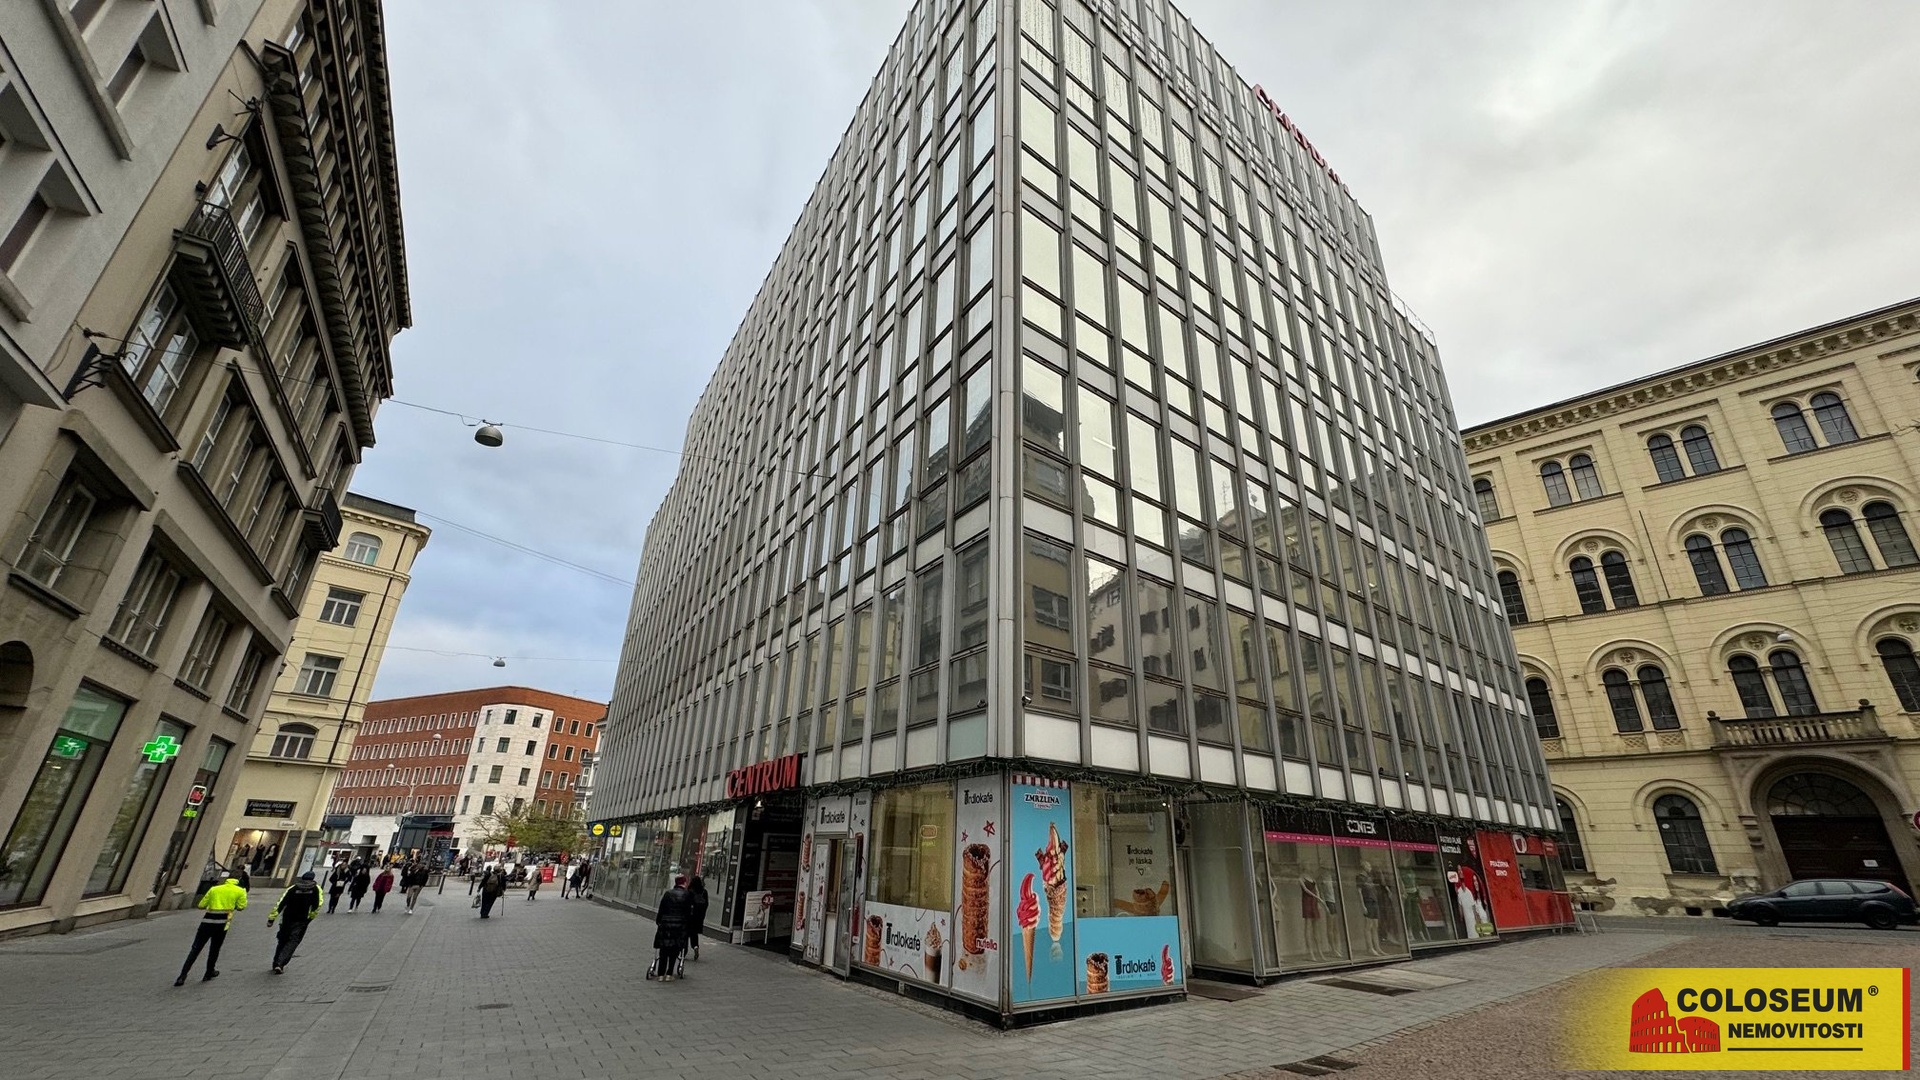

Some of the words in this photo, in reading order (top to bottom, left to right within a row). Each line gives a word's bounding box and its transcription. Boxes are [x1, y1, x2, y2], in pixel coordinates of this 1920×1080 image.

[727, 753, 799, 799] CENTRUM
[1024, 794, 1060, 804] ZMRZLINA
[1346, 819, 1377, 834] CONTEX
[976, 938, 998, 951] nutella
